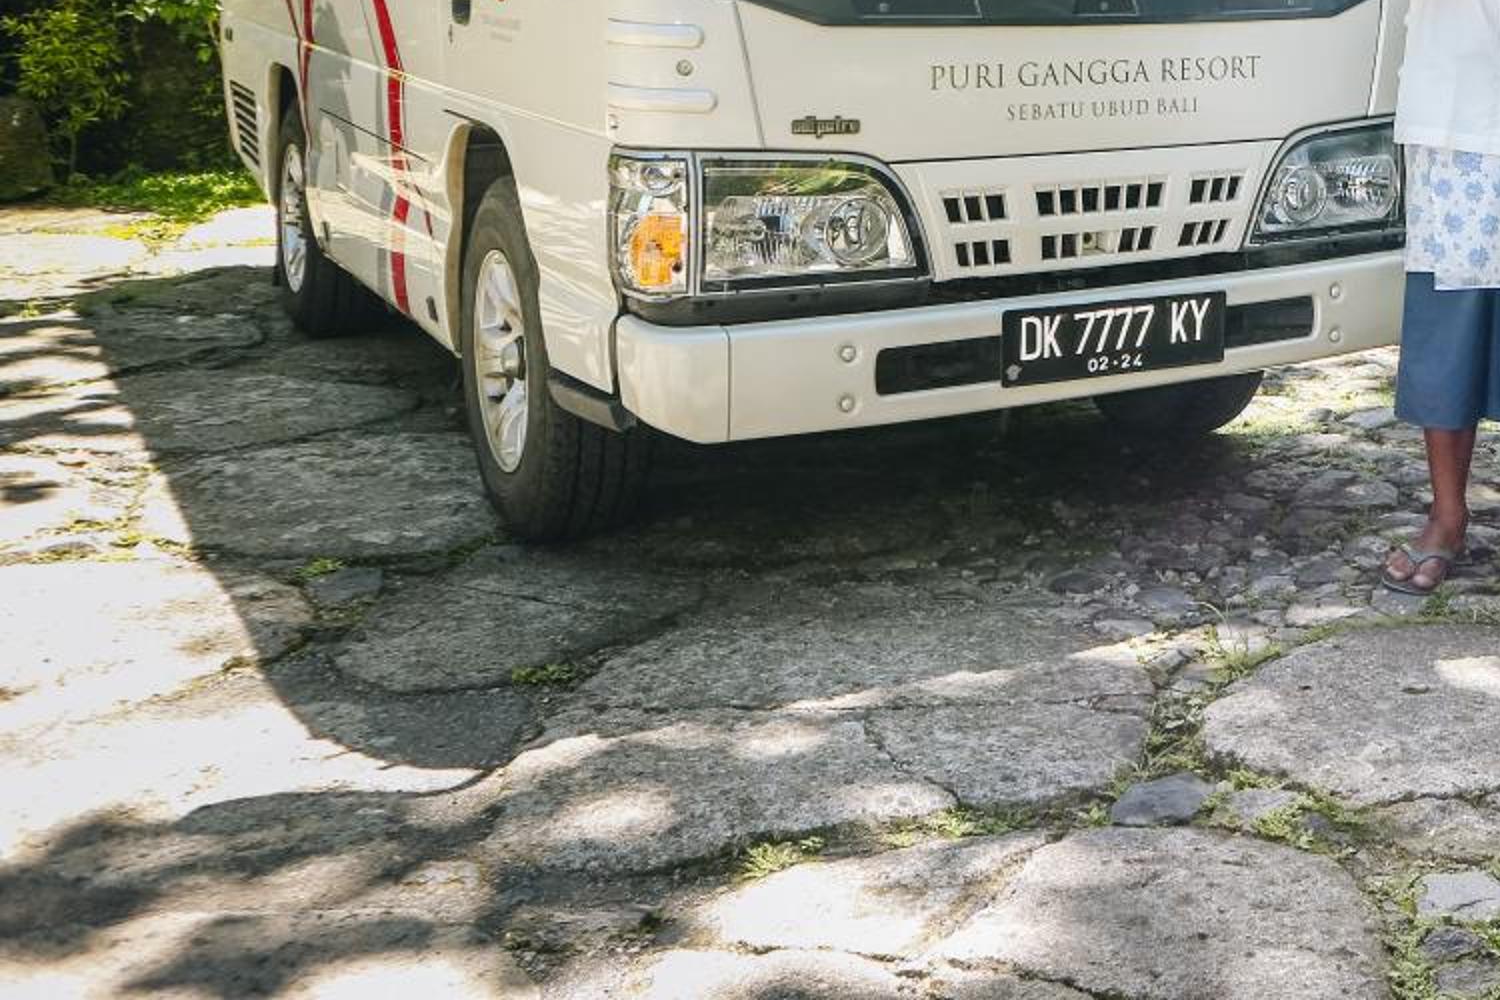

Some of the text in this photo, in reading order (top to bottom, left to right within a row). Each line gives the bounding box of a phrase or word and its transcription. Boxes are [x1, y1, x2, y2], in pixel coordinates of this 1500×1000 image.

[929, 54, 1262, 91] PURI GANGGA RESORT
[1006, 96, 1198, 122] SEBATU UBUD BALI
[1020, 298, 1211, 361] DK 7777 KY
